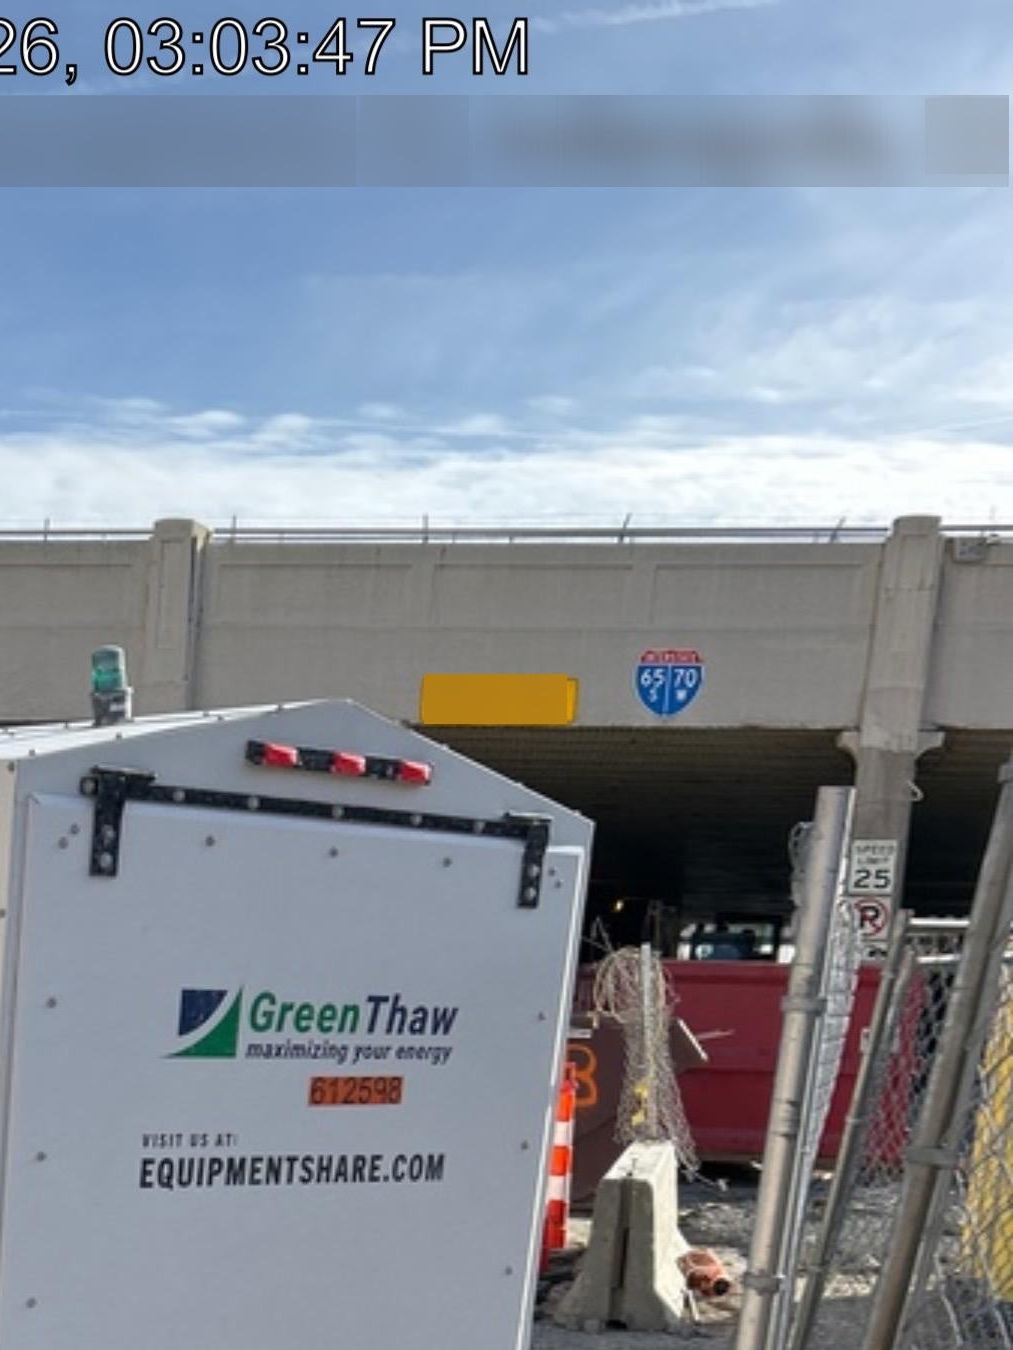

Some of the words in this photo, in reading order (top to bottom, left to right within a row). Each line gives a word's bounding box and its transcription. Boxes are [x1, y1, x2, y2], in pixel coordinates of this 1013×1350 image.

[640, 668, 665, 688] 65
[673, 668, 697, 688] 70
[853, 868, 891, 889] 25
[244, 1038, 349, 1064] maximizing
[351, 1044, 392, 1065] your
[394, 1044, 453, 1065] energy
[309, 1077, 402, 1106] 612598
[142, 1133, 183, 1148] VISIT
[189, 1133, 209, 1147] US
[139, 1153, 446, 1190] EQUIPMENTSHARE.COM
